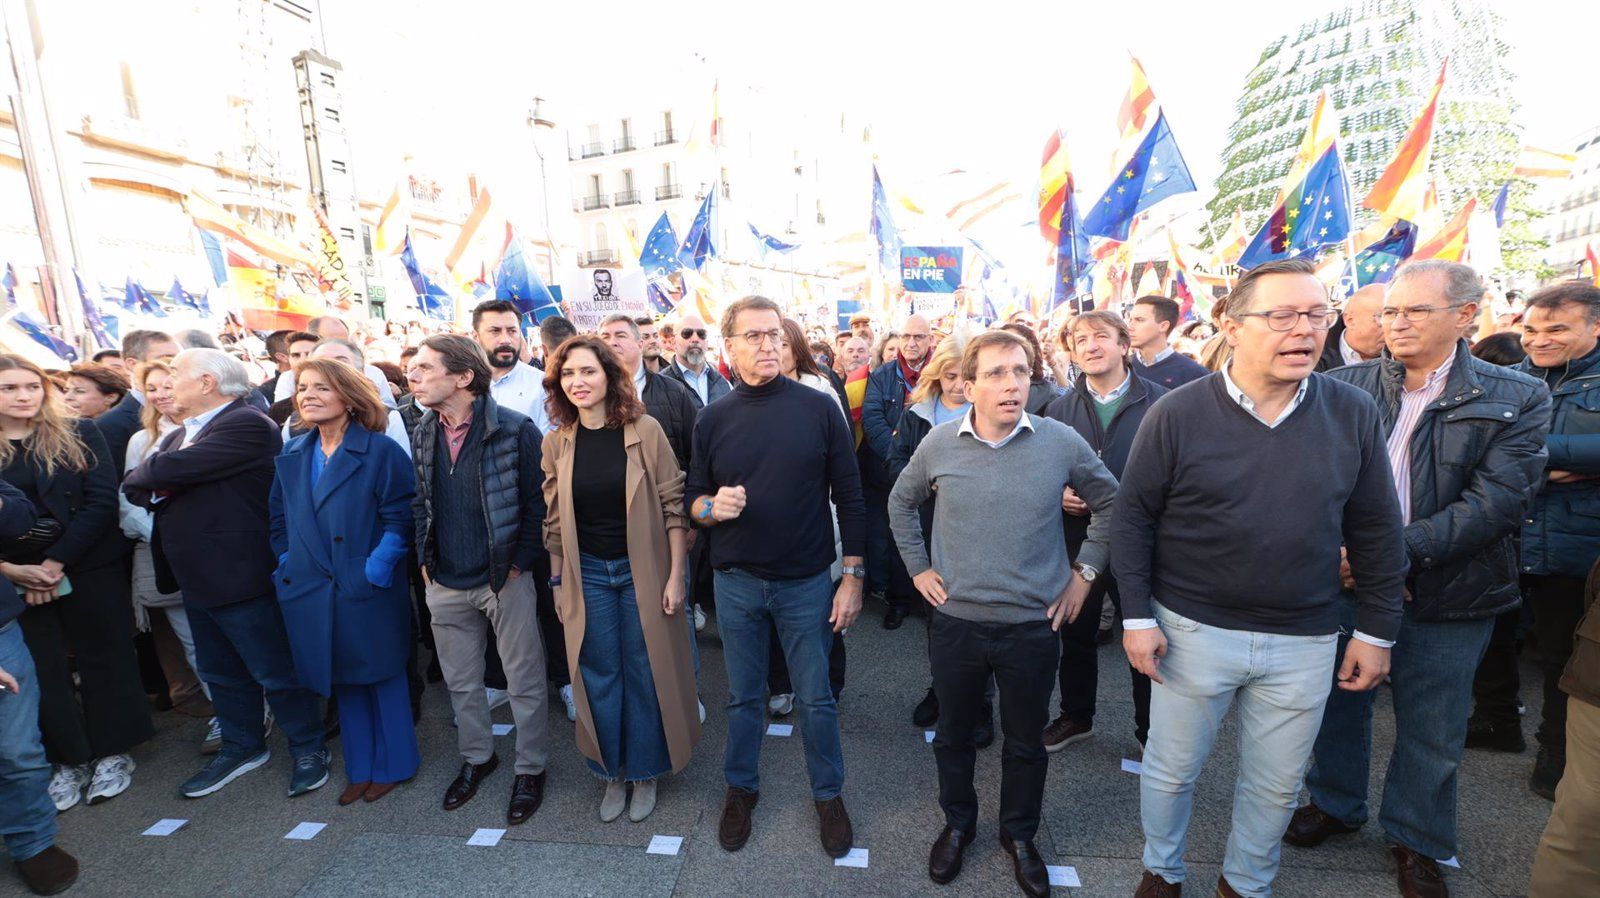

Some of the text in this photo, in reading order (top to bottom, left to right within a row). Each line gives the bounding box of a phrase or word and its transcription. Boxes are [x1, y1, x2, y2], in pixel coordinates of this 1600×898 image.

[904, 253, 957, 267] ESPAÑA
[904, 268, 944, 280] EN PIE
[570, 301, 582, 312] EN
[583, 301, 592, 312] SU
[593, 301, 612, 312] JUEGO
[613, 301, 621, 311] DE
